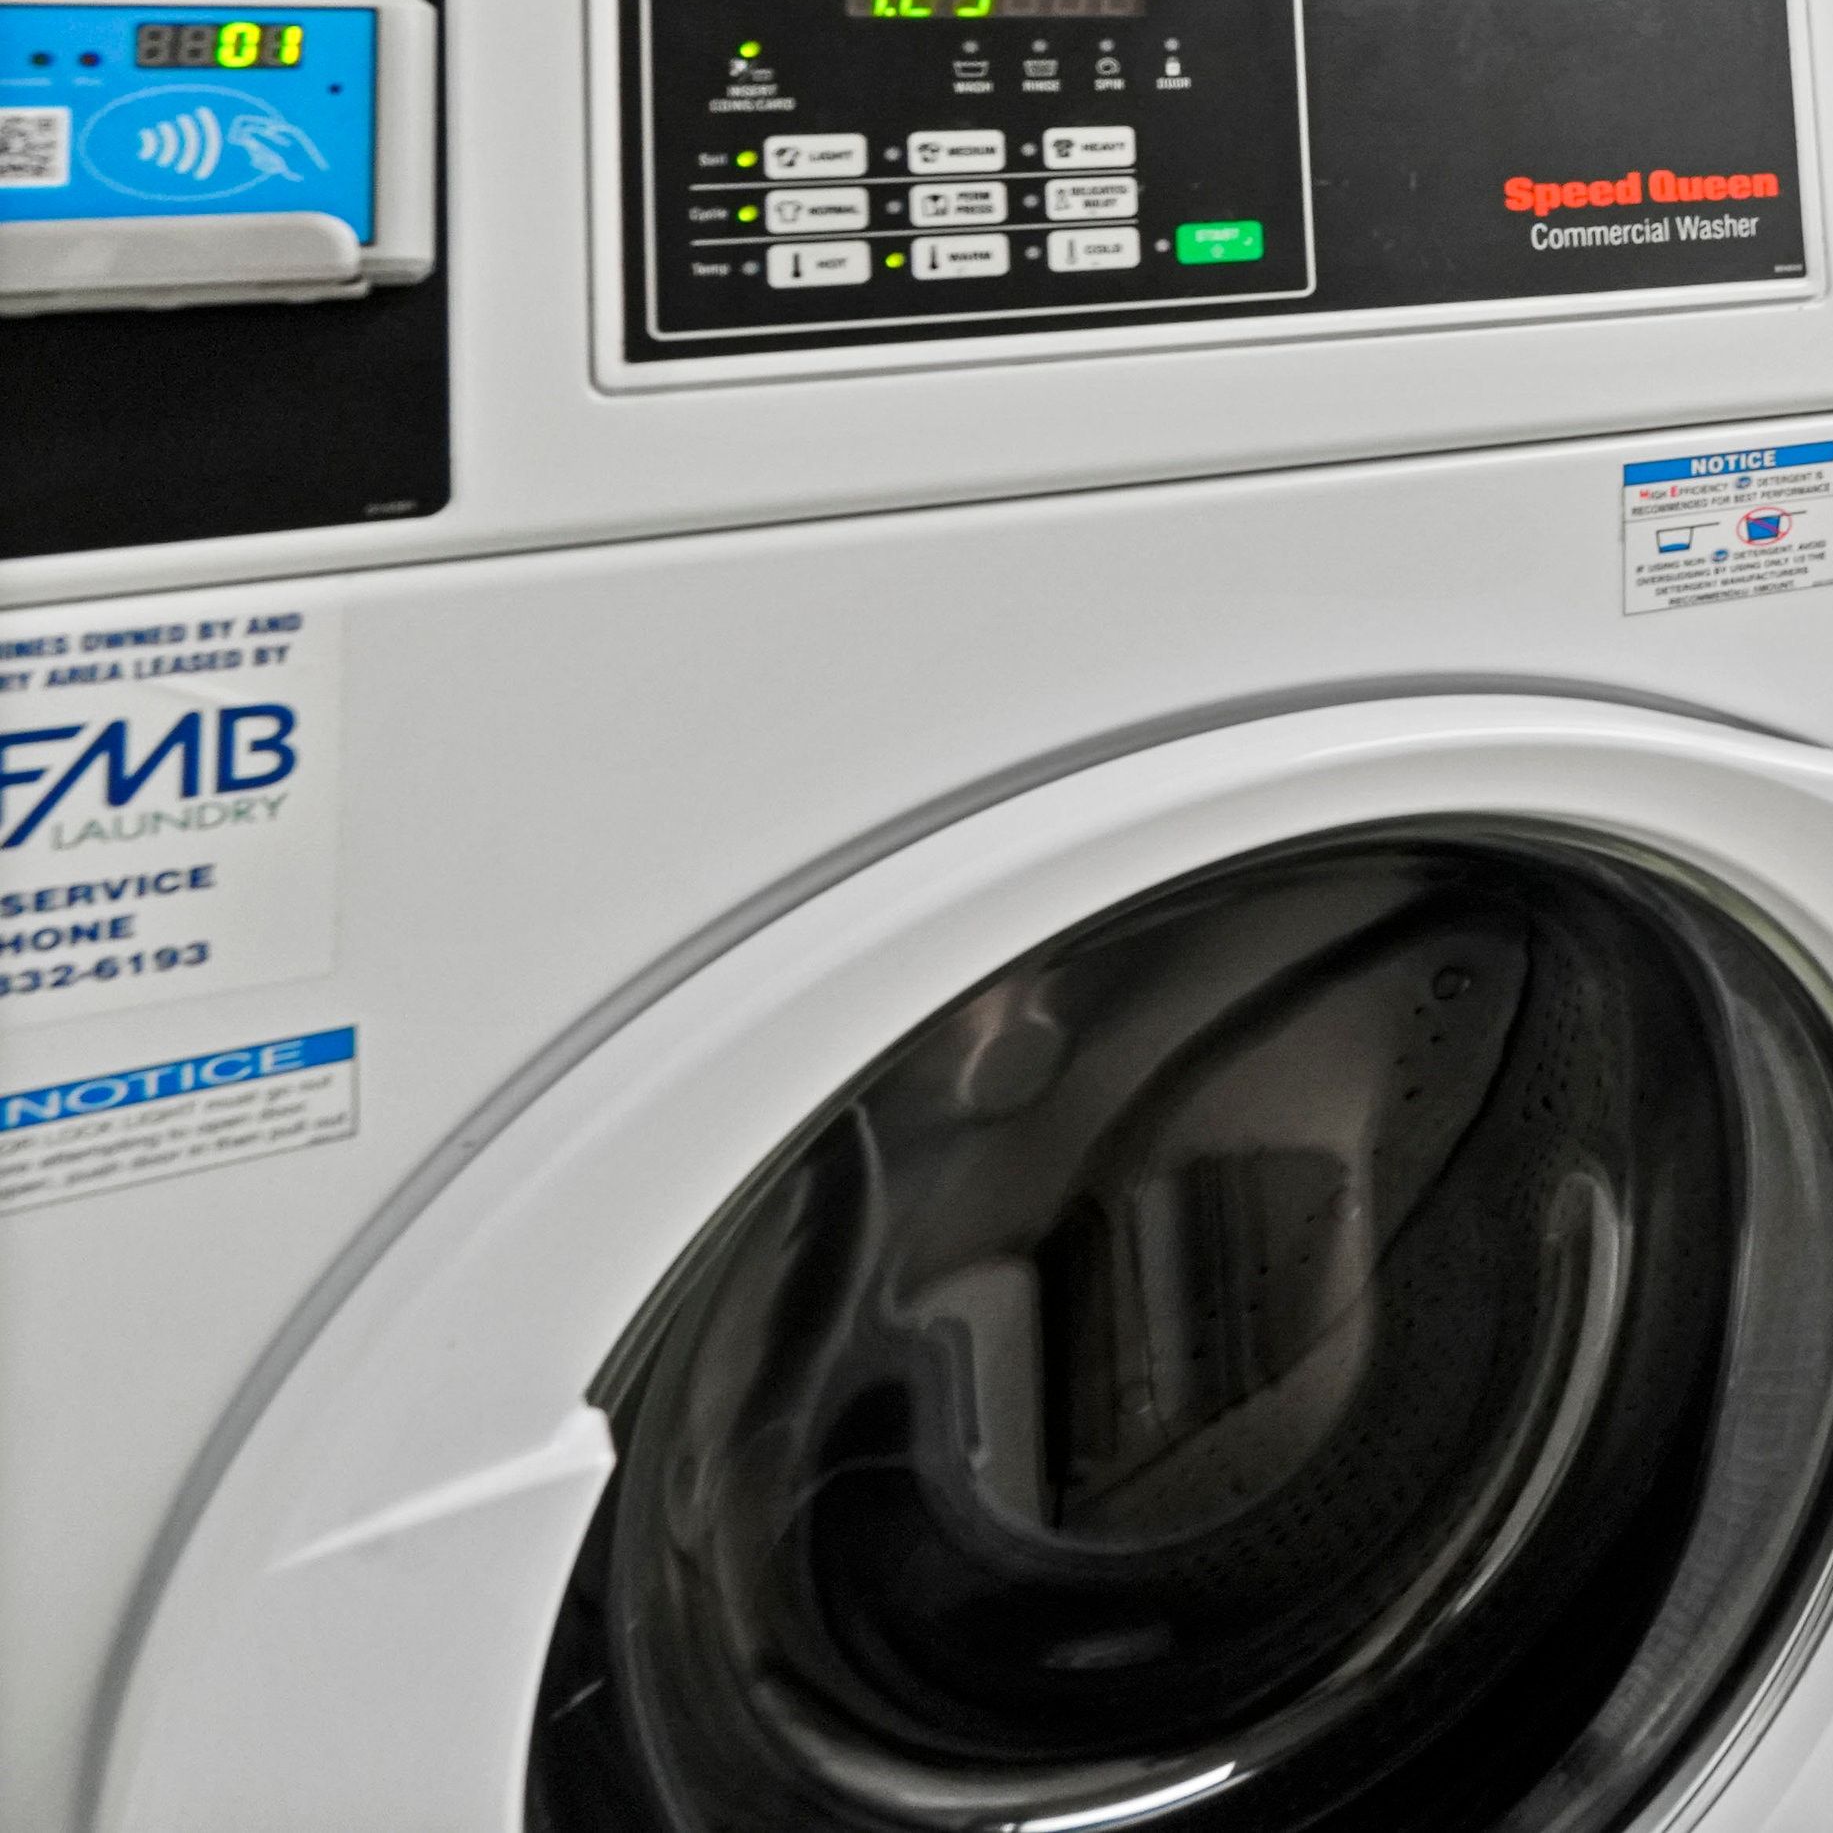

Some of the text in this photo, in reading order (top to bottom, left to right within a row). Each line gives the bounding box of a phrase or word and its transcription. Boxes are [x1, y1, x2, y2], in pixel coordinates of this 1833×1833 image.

[215, 21, 304, 68] 01
[1504, 170, 1779, 216] Speed Queen
[1531, 214, 1759, 250] Commercial Washer
[1691, 450, 1776, 476] NOTICE
[80, 623, 187, 653] OWNED
[198, 619, 235, 641] BY
[246, 612, 304, 636] AND
[44, 662, 123, 688] AREA
[132, 648, 243, 680] LEASED
[252, 642, 290, 667] BY
[52, 792, 290, 852] LAUNDRY
[0, 864, 216, 917] SERVICE
[5, 1039, 308, 1127] NOTICE
